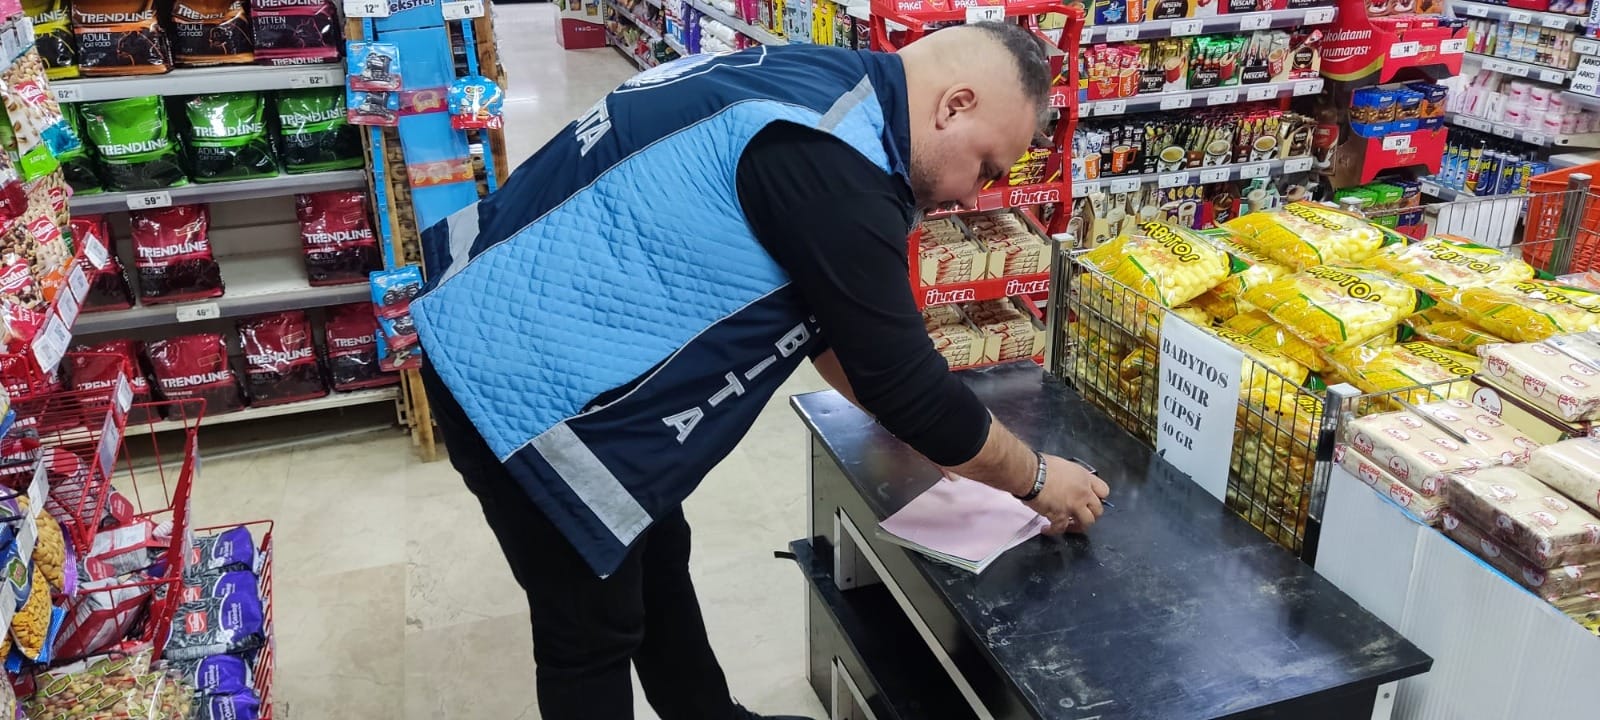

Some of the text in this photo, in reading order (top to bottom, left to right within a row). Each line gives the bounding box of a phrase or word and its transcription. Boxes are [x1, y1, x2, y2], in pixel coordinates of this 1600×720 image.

[80, 9, 154, 24] TRENDLINE
[258, 16, 287, 25] KITTEN
[82, 33, 112, 42] ADULT
[1322, 30, 1372, 41] ikolatanın
[271, 57, 325, 67] TRENDLINE
[1577, 70, 1596, 79] ARKO
[1573, 82, 1592, 91] ARKO
[280, 107, 347, 125] TRENDLINE
[192, 122, 263, 137] TRENDLINE
[97, 138, 169, 156] TRENDLINE
[1010, 190, 1060, 207] ÜLKER
[303, 229, 373, 244] TRENDLINE
[137, 240, 208, 258] TRENDLINE
[925, 288, 975, 306] ÜLKER
[246, 347, 313, 365] TRENDLINE
[1162, 337, 1229, 389] BABYTOS
[161, 370, 231, 387] TRENDLINE
[662, 319, 815, 445] BITA
[1166, 368, 1209, 408] MISIR
[1164, 394, 1203, 432] CİPSİ
[1162, 420, 1193, 451] 40 GR
